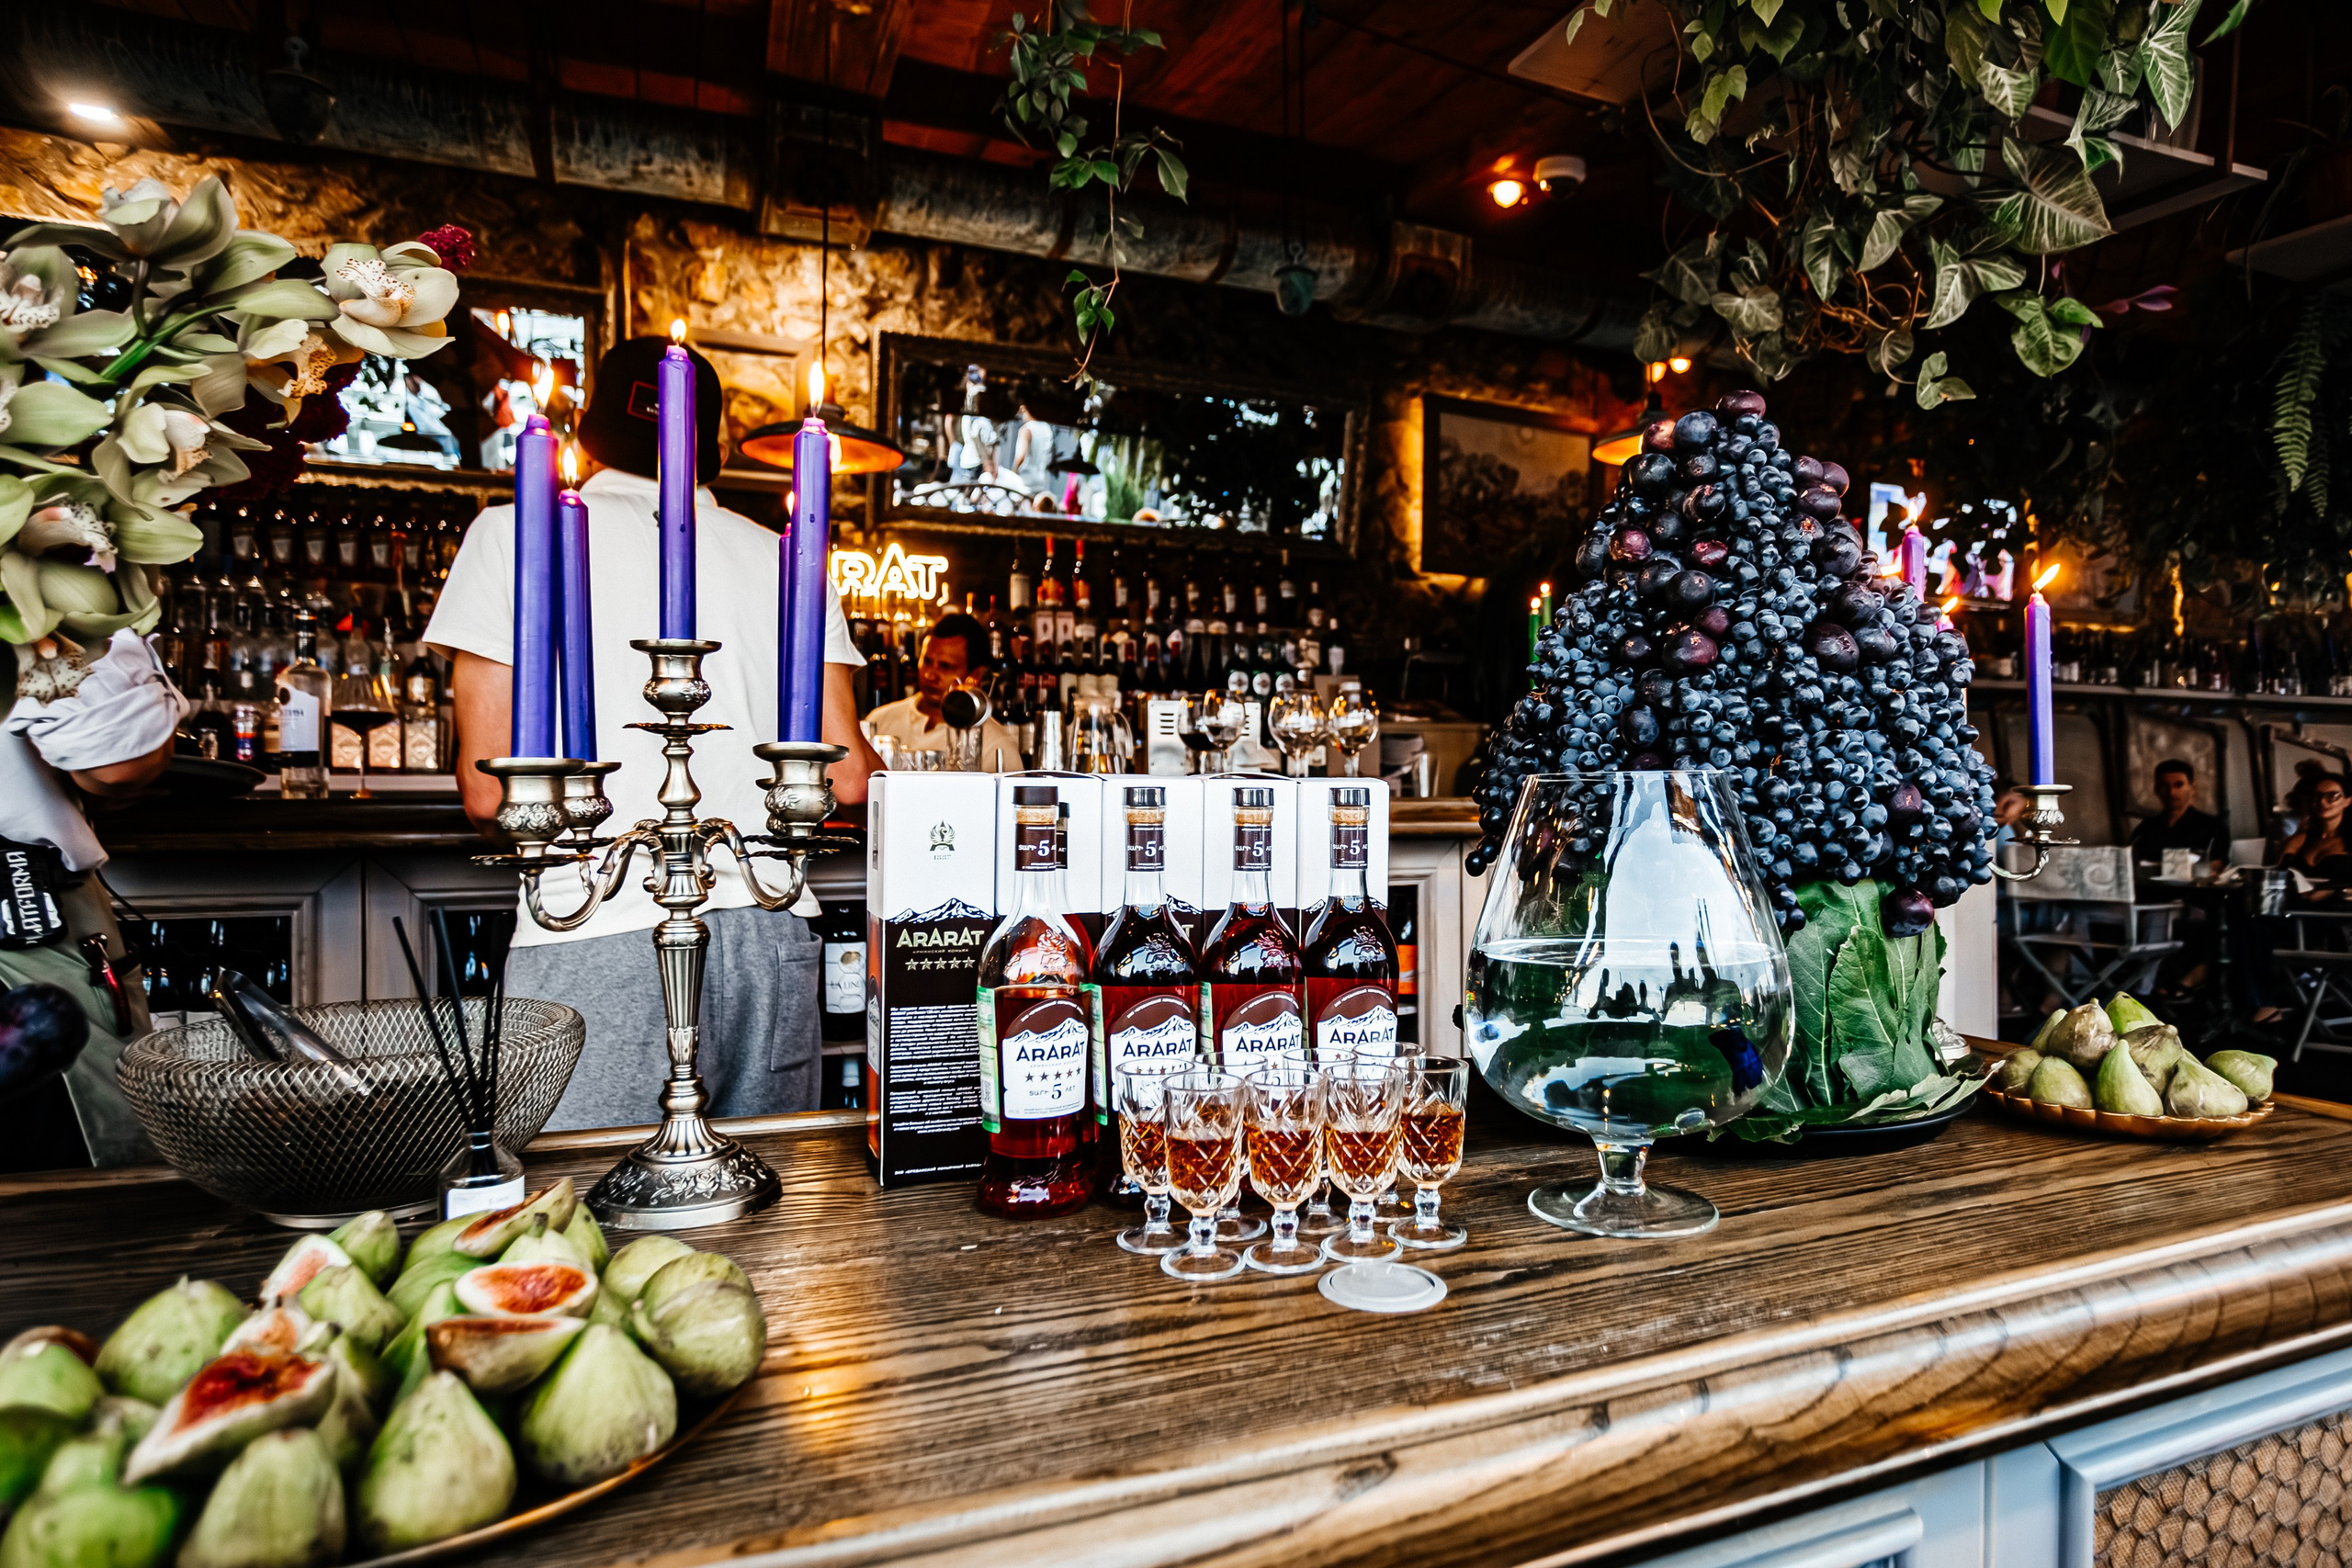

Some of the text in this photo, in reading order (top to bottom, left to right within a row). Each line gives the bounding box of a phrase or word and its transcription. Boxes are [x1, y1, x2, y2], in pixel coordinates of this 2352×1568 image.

[1037, 840, 1050, 857] 5
[1145, 840, 1157, 856] 5
[1252, 841, 1263, 856] 5
[1350, 840, 1361, 855] 5
[896, 926, 985, 948] ARARAT
[1236, 1032, 1300, 1053] ARARAT
[1329, 1026, 1394, 1044] ARARAT
[1016, 1040, 1086, 1062] ARARAT
[1123, 1037, 1193, 1057] ARARAT
[1051, 1083, 1062, 1100] 5
